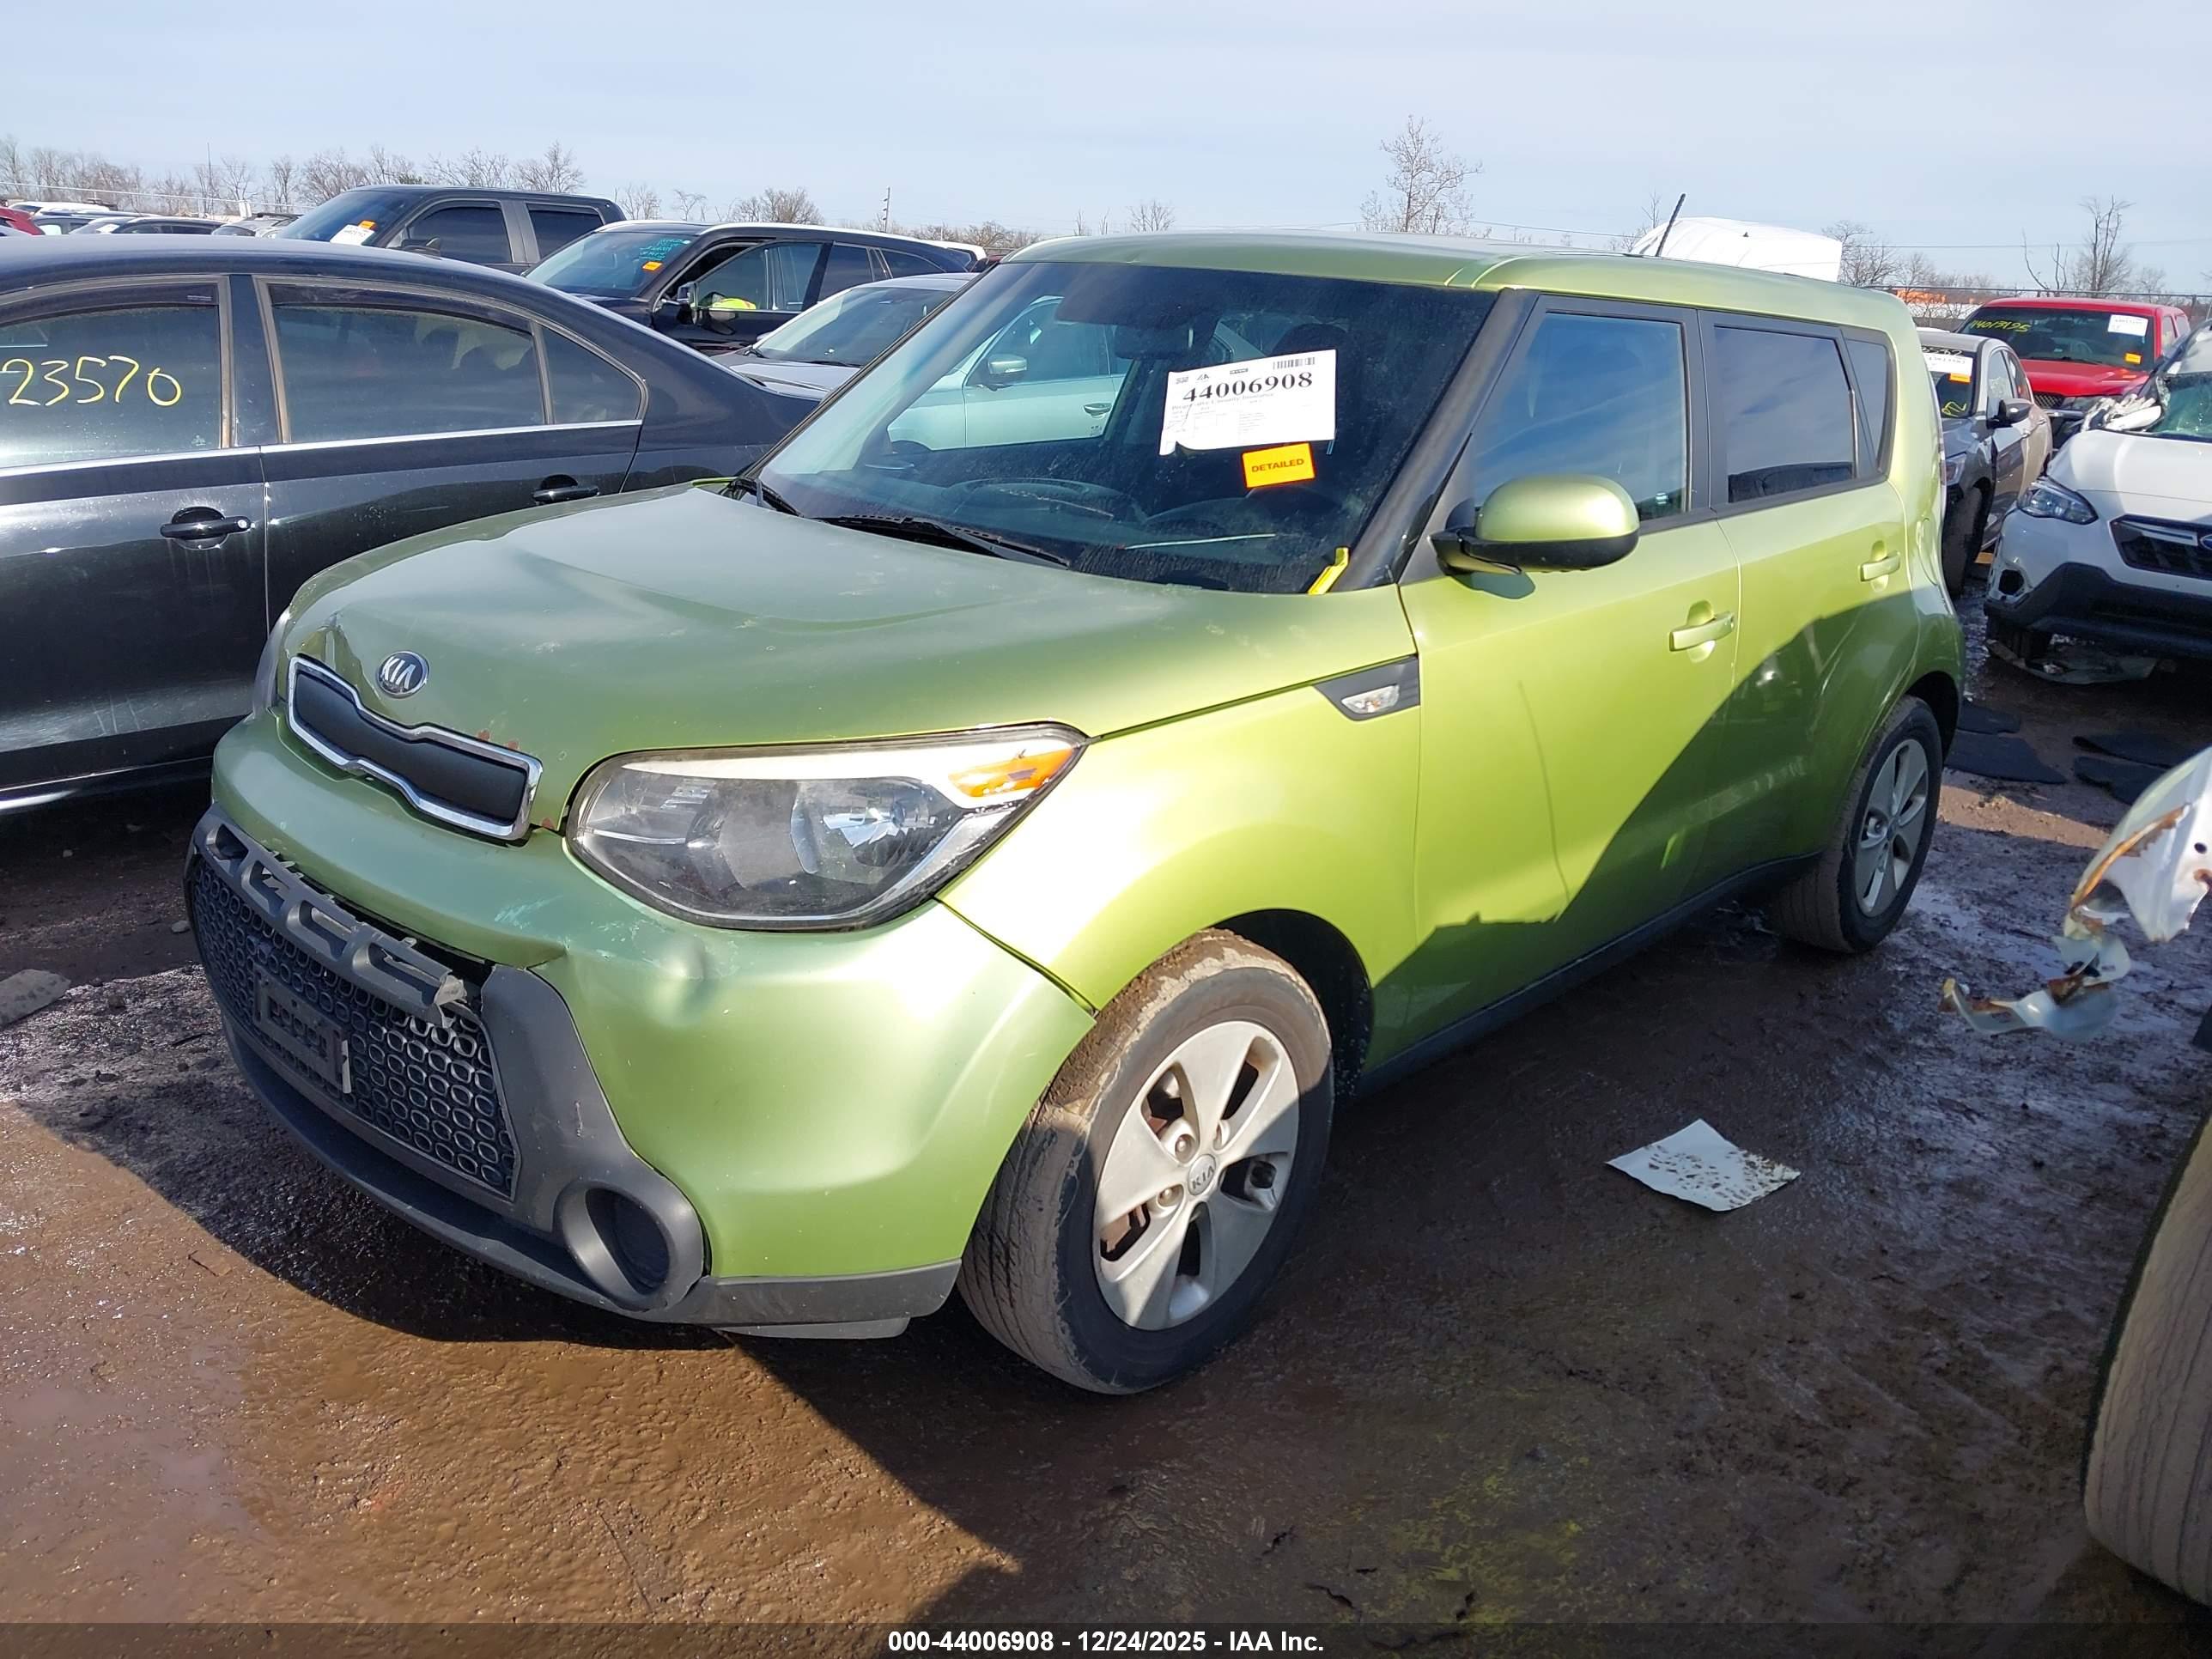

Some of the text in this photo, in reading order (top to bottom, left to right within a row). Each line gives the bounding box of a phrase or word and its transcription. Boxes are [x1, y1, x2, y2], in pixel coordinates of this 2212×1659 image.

[2, 355, 182, 407] 23570
[1182, 372, 1313, 402] 44006908
[1251, 458, 1304, 473] DETAILED
[380, 656, 416, 690] KIA
[1191, 1165, 1215, 1189] KIA
